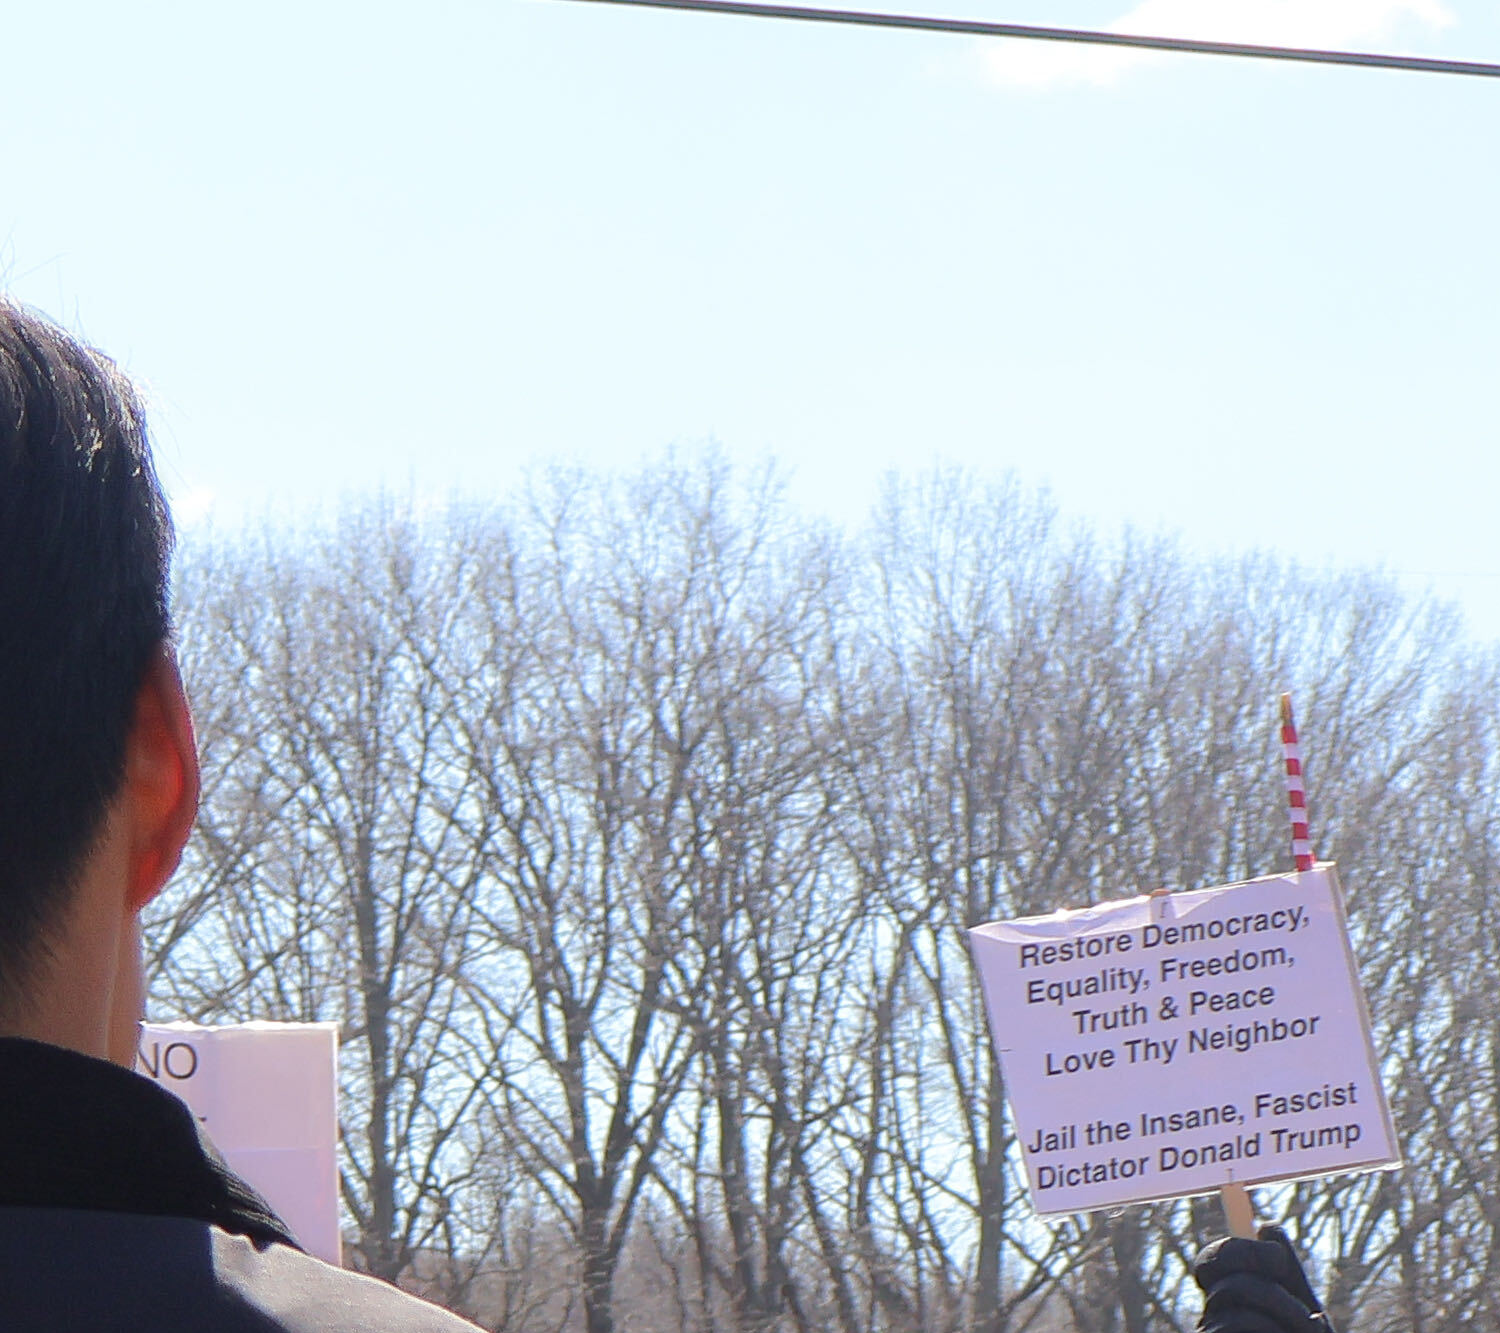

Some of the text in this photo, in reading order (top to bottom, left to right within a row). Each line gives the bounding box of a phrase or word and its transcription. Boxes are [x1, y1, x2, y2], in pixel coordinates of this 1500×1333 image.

[1019, 906, 1309, 968] Restore Democracy,
[1027, 947, 1295, 1006] Equality, Freedom,
[1072, 986, 1275, 1034] Truth & Peace
[1046, 1016, 1320, 1076] Love Thy Neighbor
[1028, 1082, 1357, 1154] Jail the Insane, Fascist
[1037, 1123, 1361, 1190] Dictator Donald Trump
